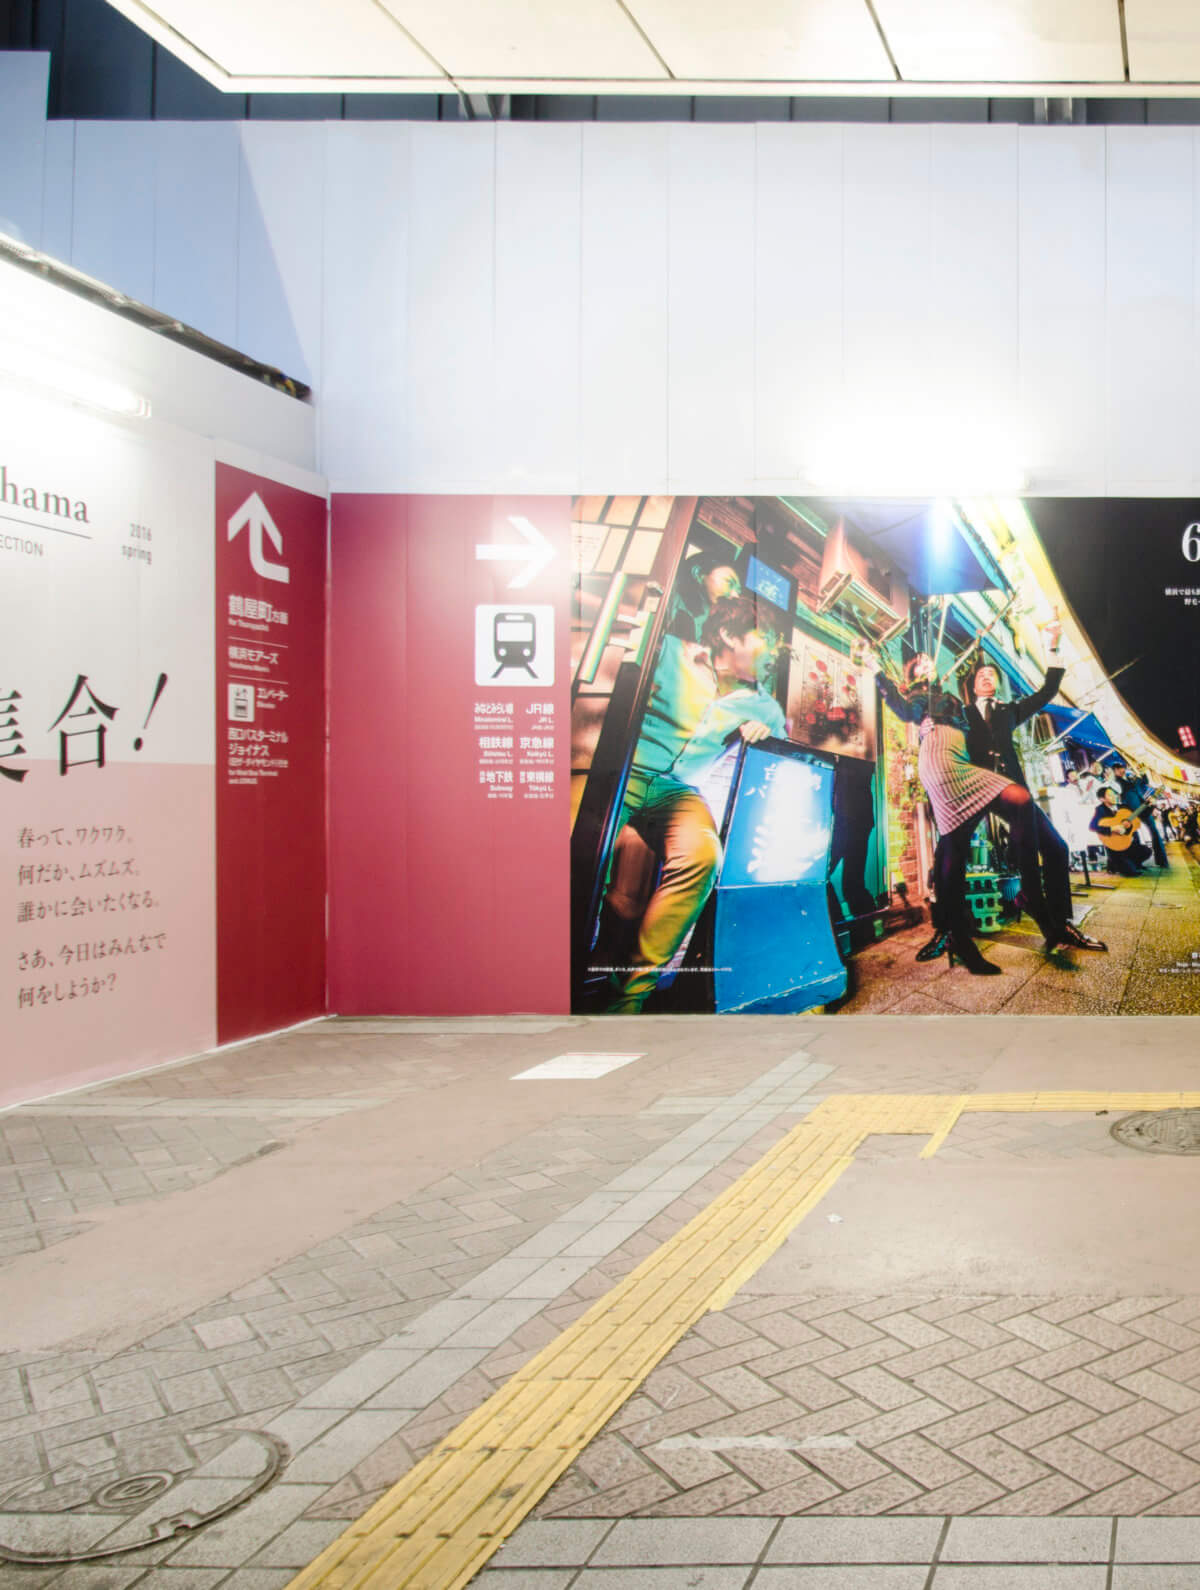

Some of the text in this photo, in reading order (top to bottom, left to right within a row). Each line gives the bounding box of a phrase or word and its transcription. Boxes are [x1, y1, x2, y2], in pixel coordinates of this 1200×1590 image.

[130, 522, 152, 542] 2016
[121, 544, 153, 566] spring
[18, 825, 134, 849] 春って、ワクワク。
[18, 858, 141, 887] 何だか、ムズムズ。
[17, 891, 160, 923] 誰かに会いたくなる。
[18, 933, 167, 971] さあ、今日はみんなで
[18, 972, 118, 1009] 何をしようか？
